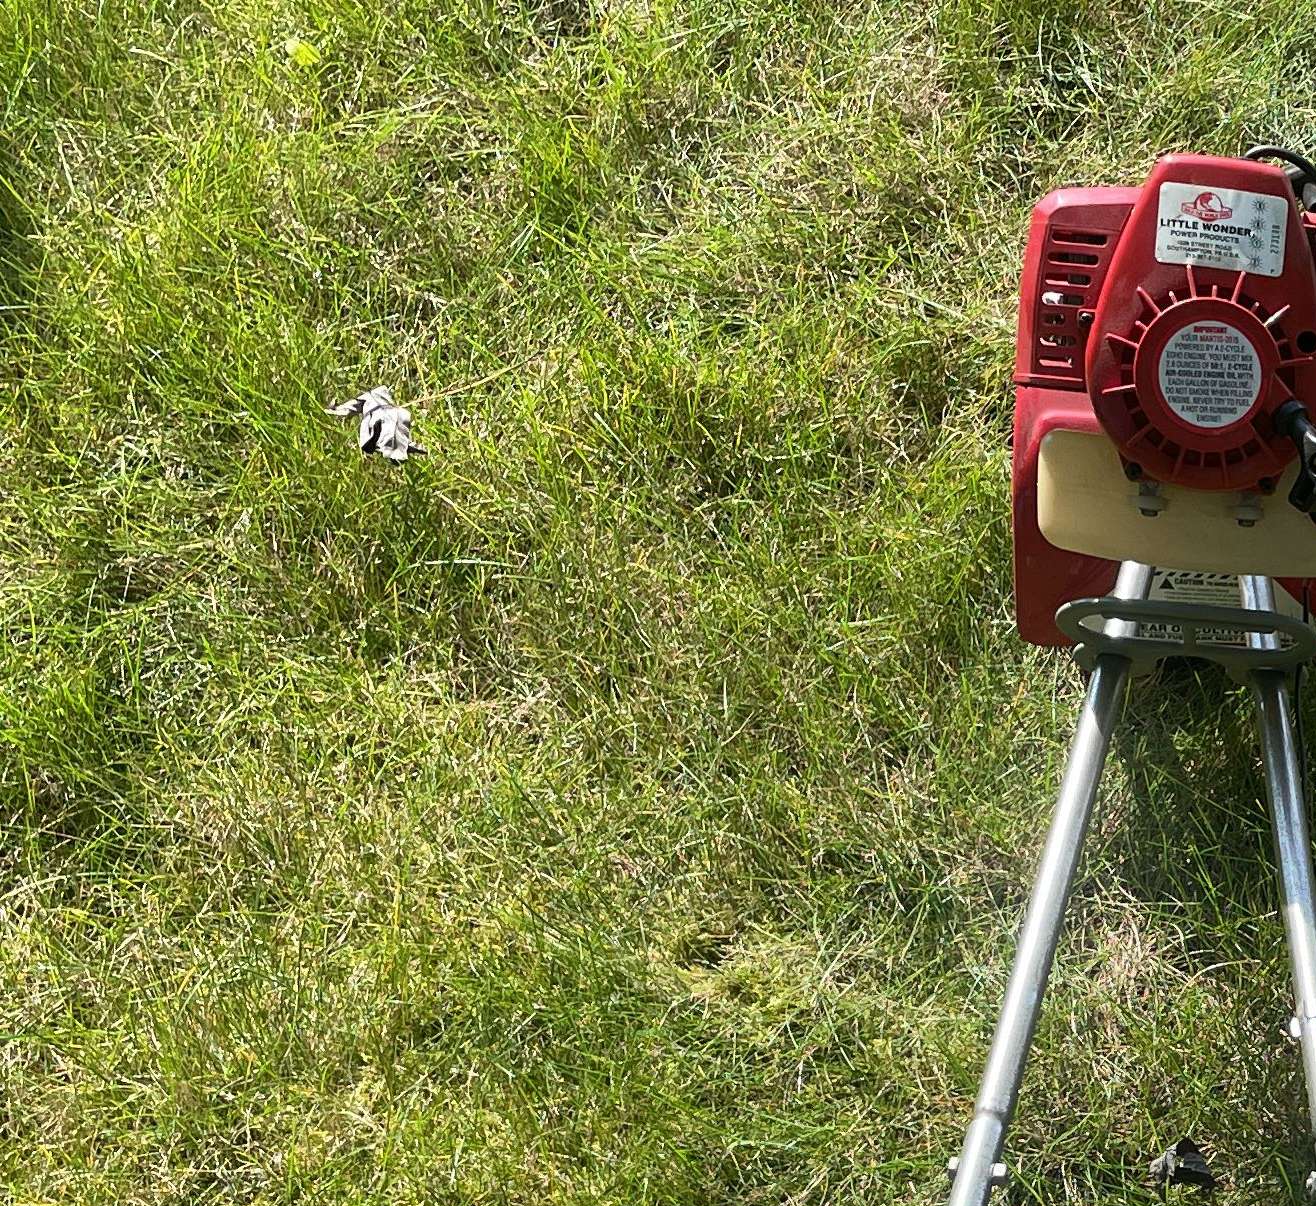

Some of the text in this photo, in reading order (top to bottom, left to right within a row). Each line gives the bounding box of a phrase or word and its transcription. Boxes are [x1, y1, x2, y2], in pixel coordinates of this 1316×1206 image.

[1160, 218, 1198, 230] LITTLE
[1170, 230, 1240, 244] POWER PRODUCTS
